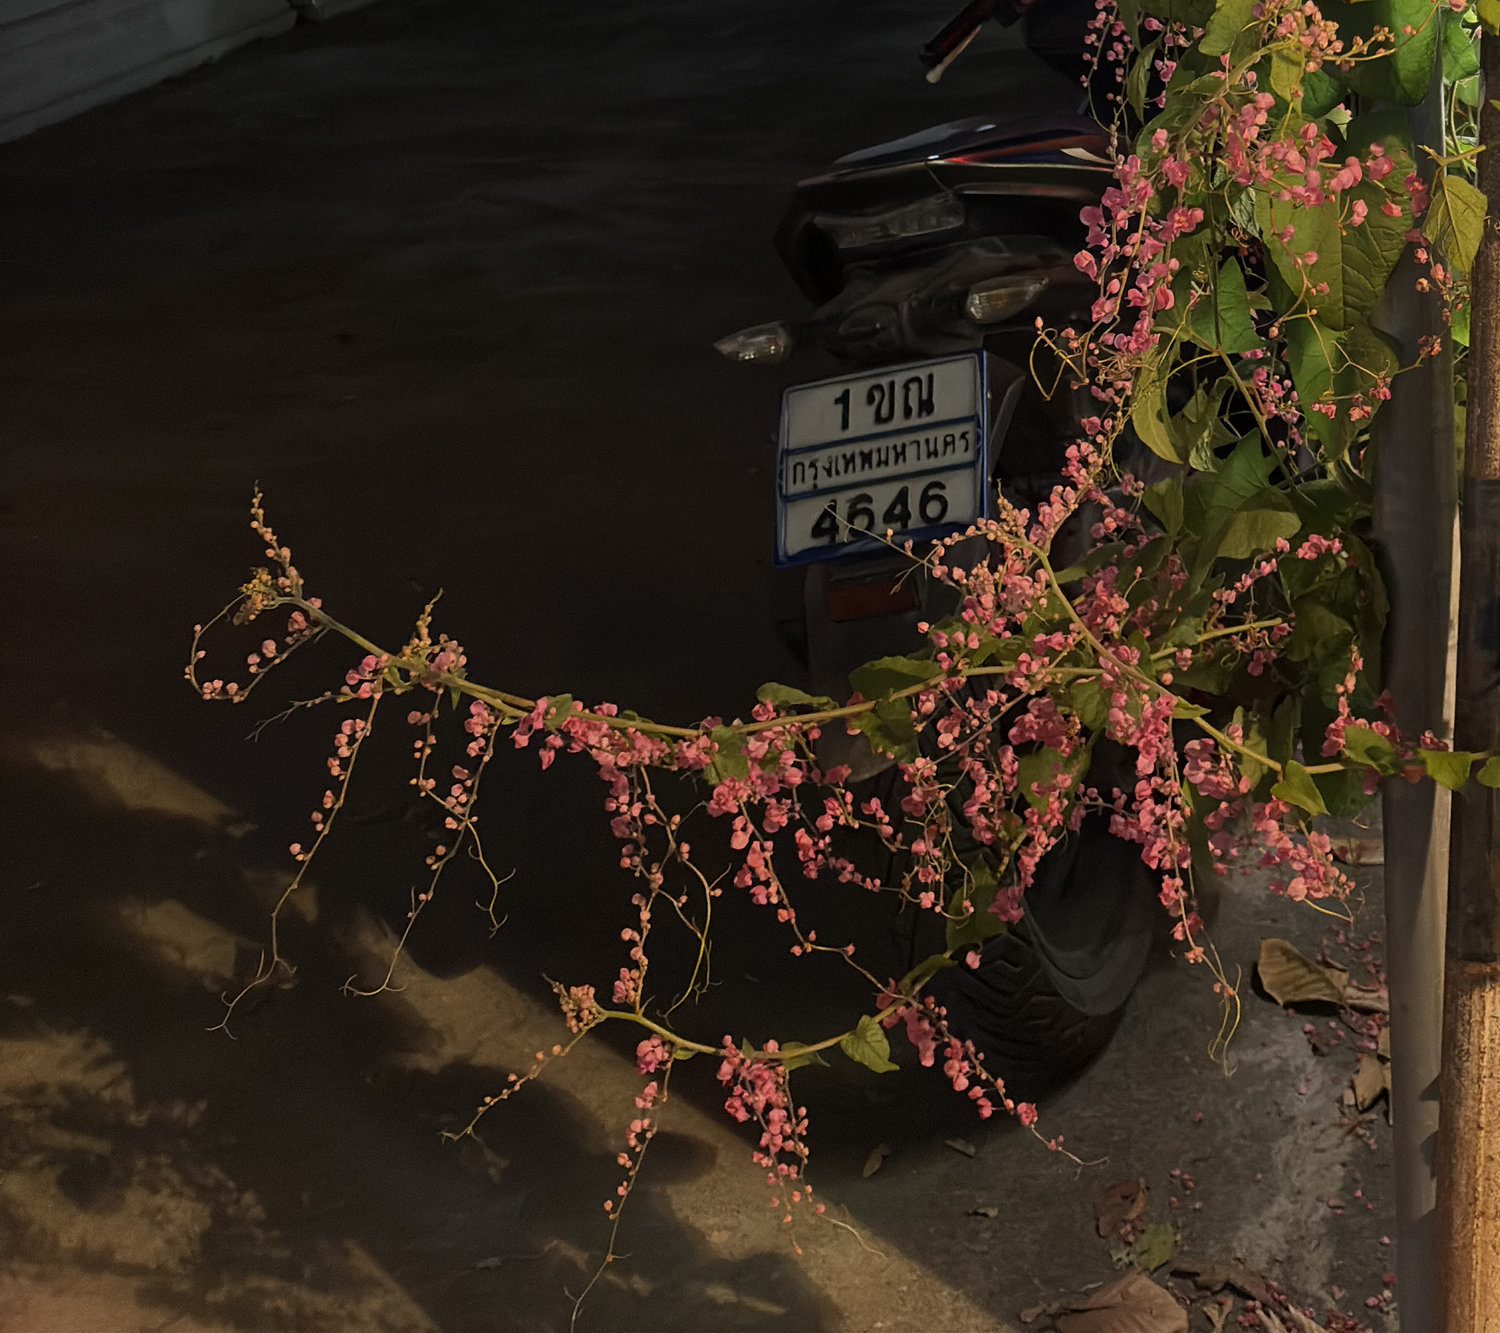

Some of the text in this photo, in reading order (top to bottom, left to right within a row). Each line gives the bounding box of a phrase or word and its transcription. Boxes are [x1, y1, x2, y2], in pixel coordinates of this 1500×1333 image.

[792, 431, 970, 489] กรุงเทพมหานคร
[811, 480, 949, 544] 4646
